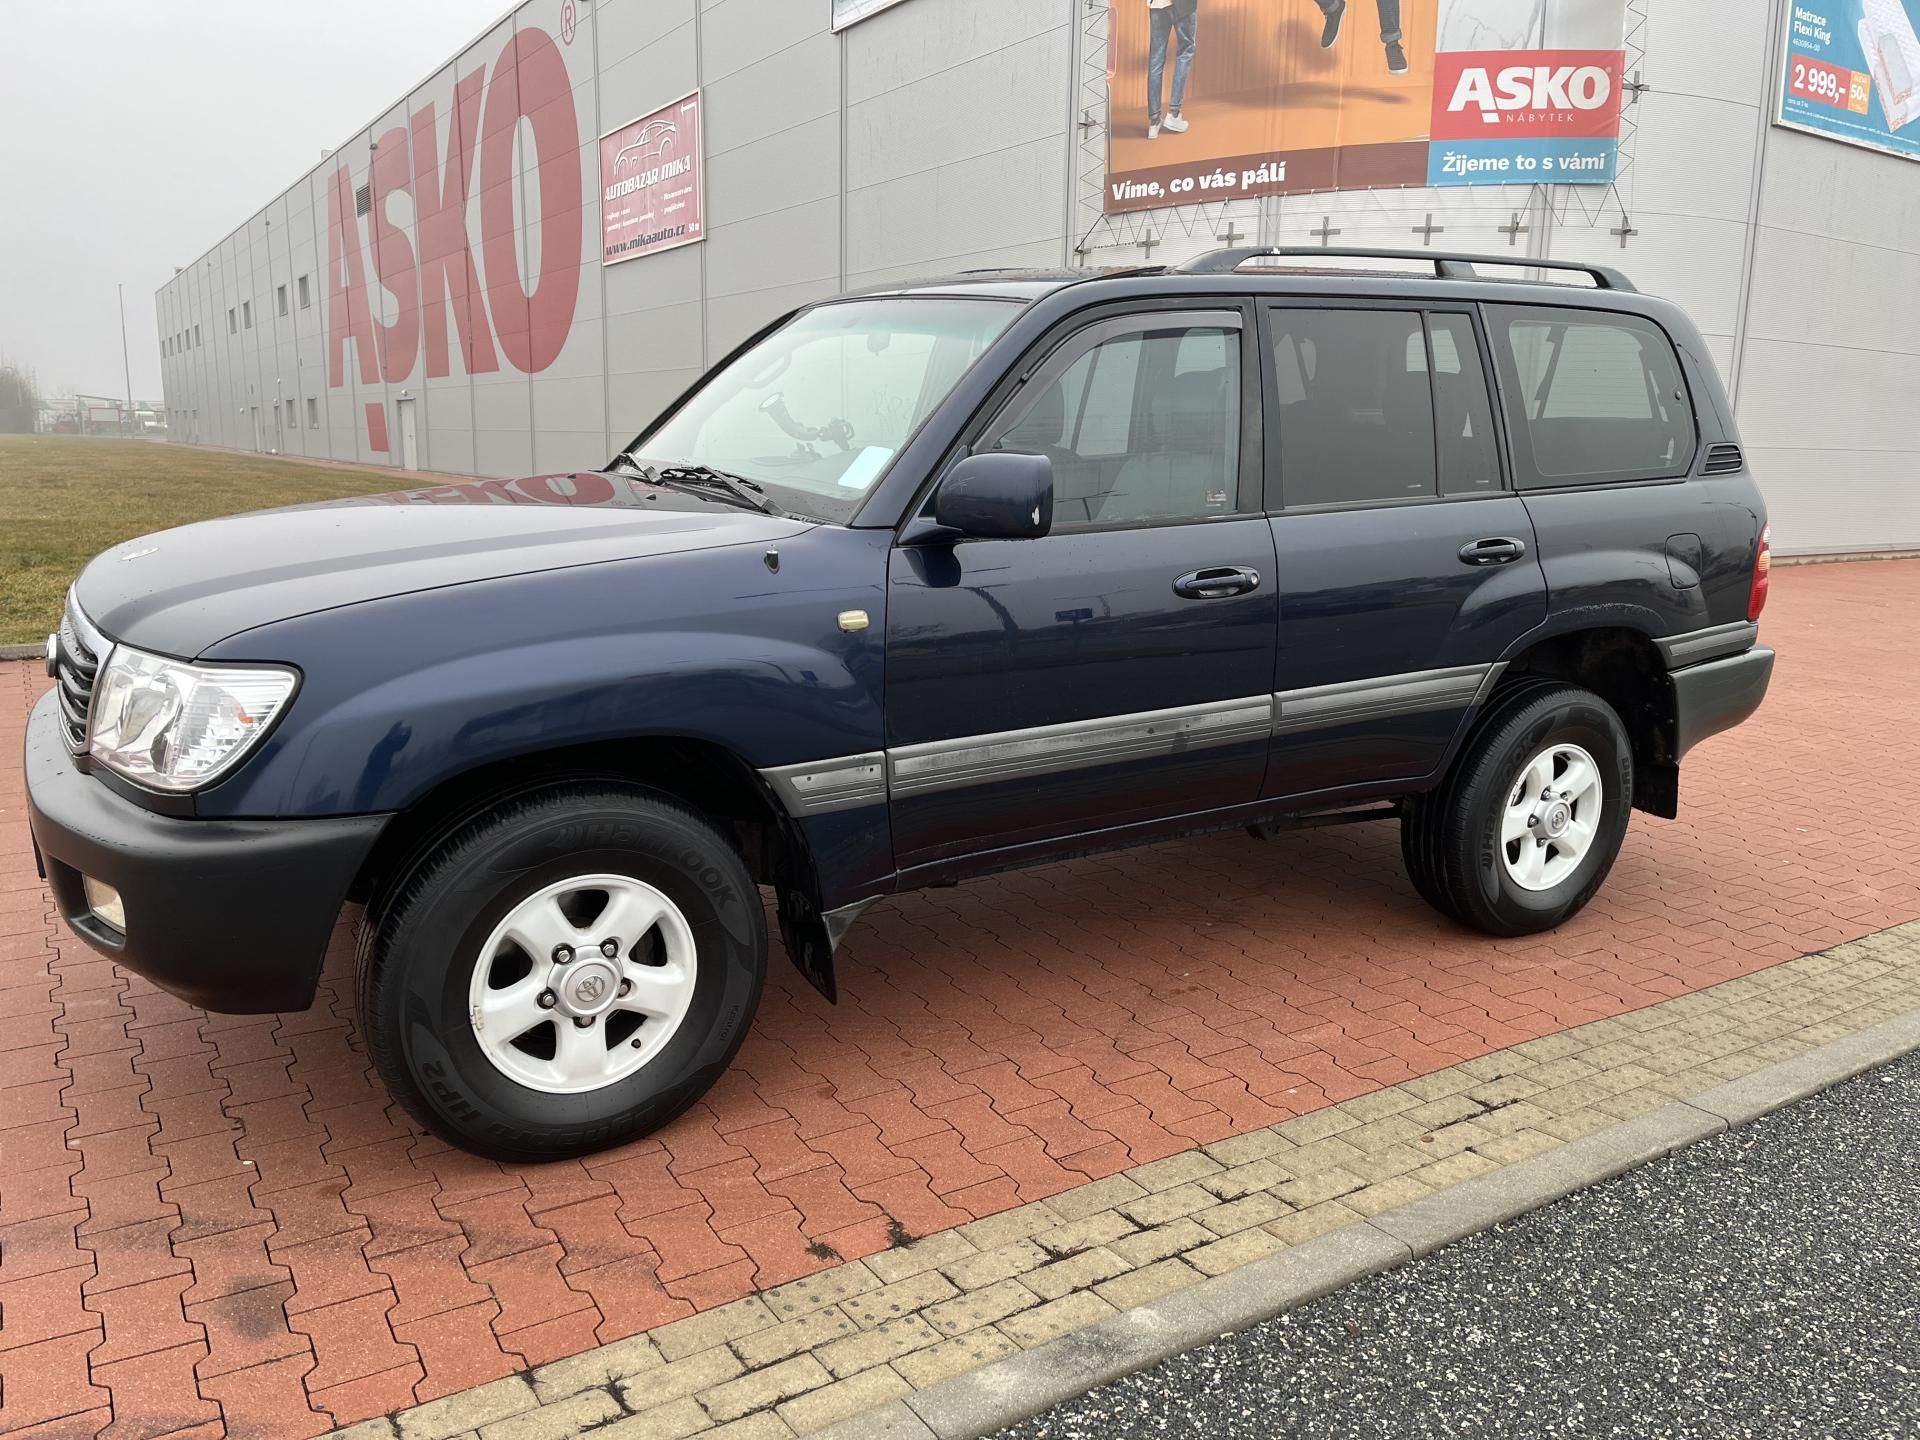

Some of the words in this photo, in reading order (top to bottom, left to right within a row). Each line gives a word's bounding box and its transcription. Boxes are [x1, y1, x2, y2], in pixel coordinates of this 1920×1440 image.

[1793, 20, 1813, 37] Flexi
[1814, 27, 1831, 45] King
[1795, 6, 1827, 26] Matrace
[1447, 66, 1611, 122] ASKO
[1506, 112, 1575, 123] NÁBYTEK
[1442, 151, 1510, 176] Žijeme
[1515, 154, 1535, 170] to
[1542, 157, 1553, 170] s
[1559, 152, 1606, 170] vámi
[604, 167, 658, 201] AUTOBAZAR
[1112, 180, 1165, 201] Víme,
[1169, 177, 1195, 193] co
[1199, 167, 1236, 190] vás
[1241, 161, 1287, 190] pálí
[327, 26, 582, 451] ASKO
[605, 223, 685, 256] www.mikaauto.cz
